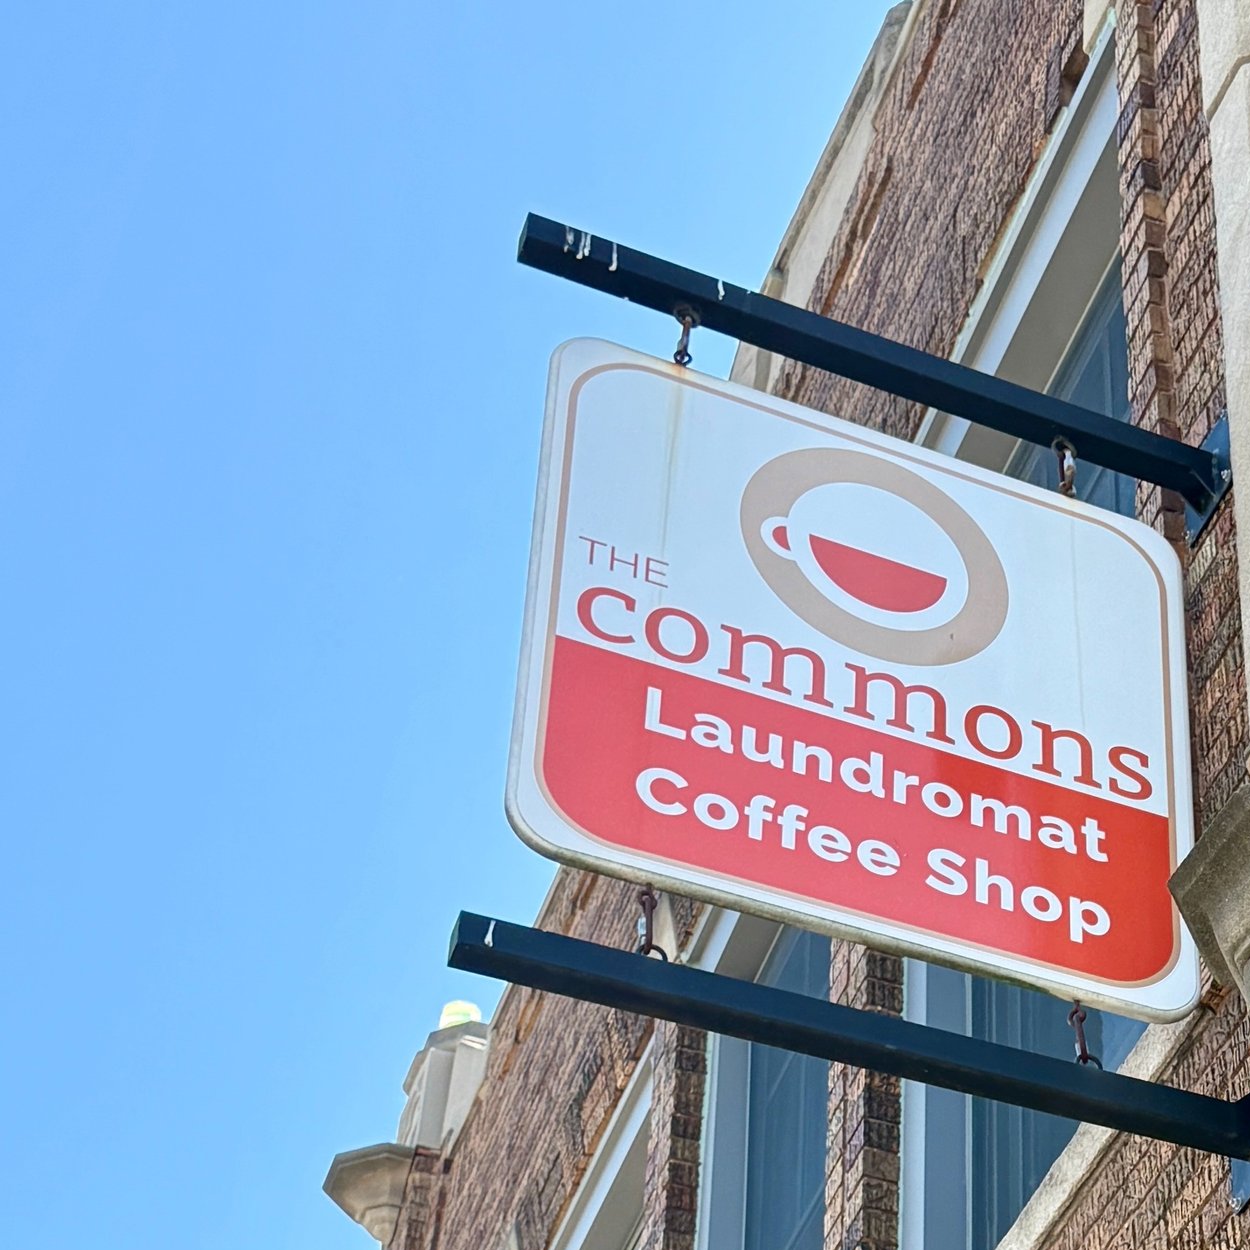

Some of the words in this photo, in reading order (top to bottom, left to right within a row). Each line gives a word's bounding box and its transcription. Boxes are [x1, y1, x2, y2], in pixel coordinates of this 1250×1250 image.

[579, 535, 670, 589] THE
[635, 767, 901, 876] Coffee
[925, 848, 1111, 944] Shop
[644, 686, 1109, 863] Laundromat
